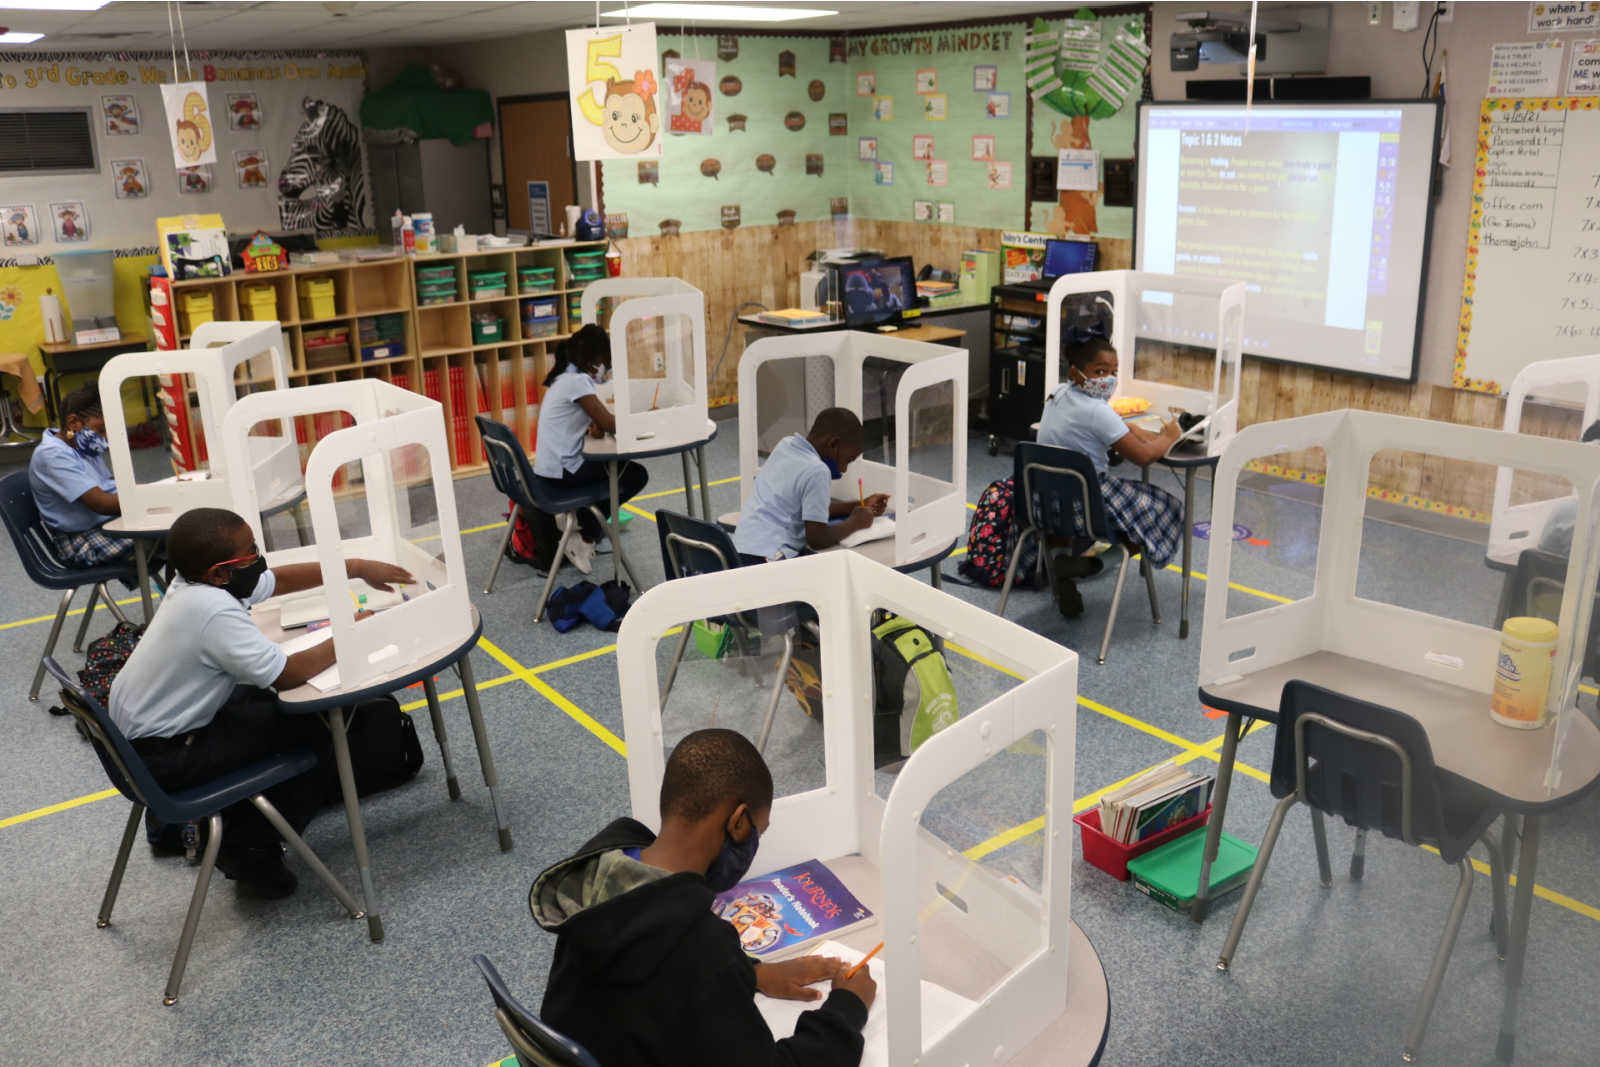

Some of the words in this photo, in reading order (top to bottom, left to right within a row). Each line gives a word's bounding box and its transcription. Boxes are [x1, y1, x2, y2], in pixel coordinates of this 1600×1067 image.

[1549, 4, 1577, 15] when
[870, 35, 933, 56] GROWTH
[24, 64, 60, 88] 3rd
